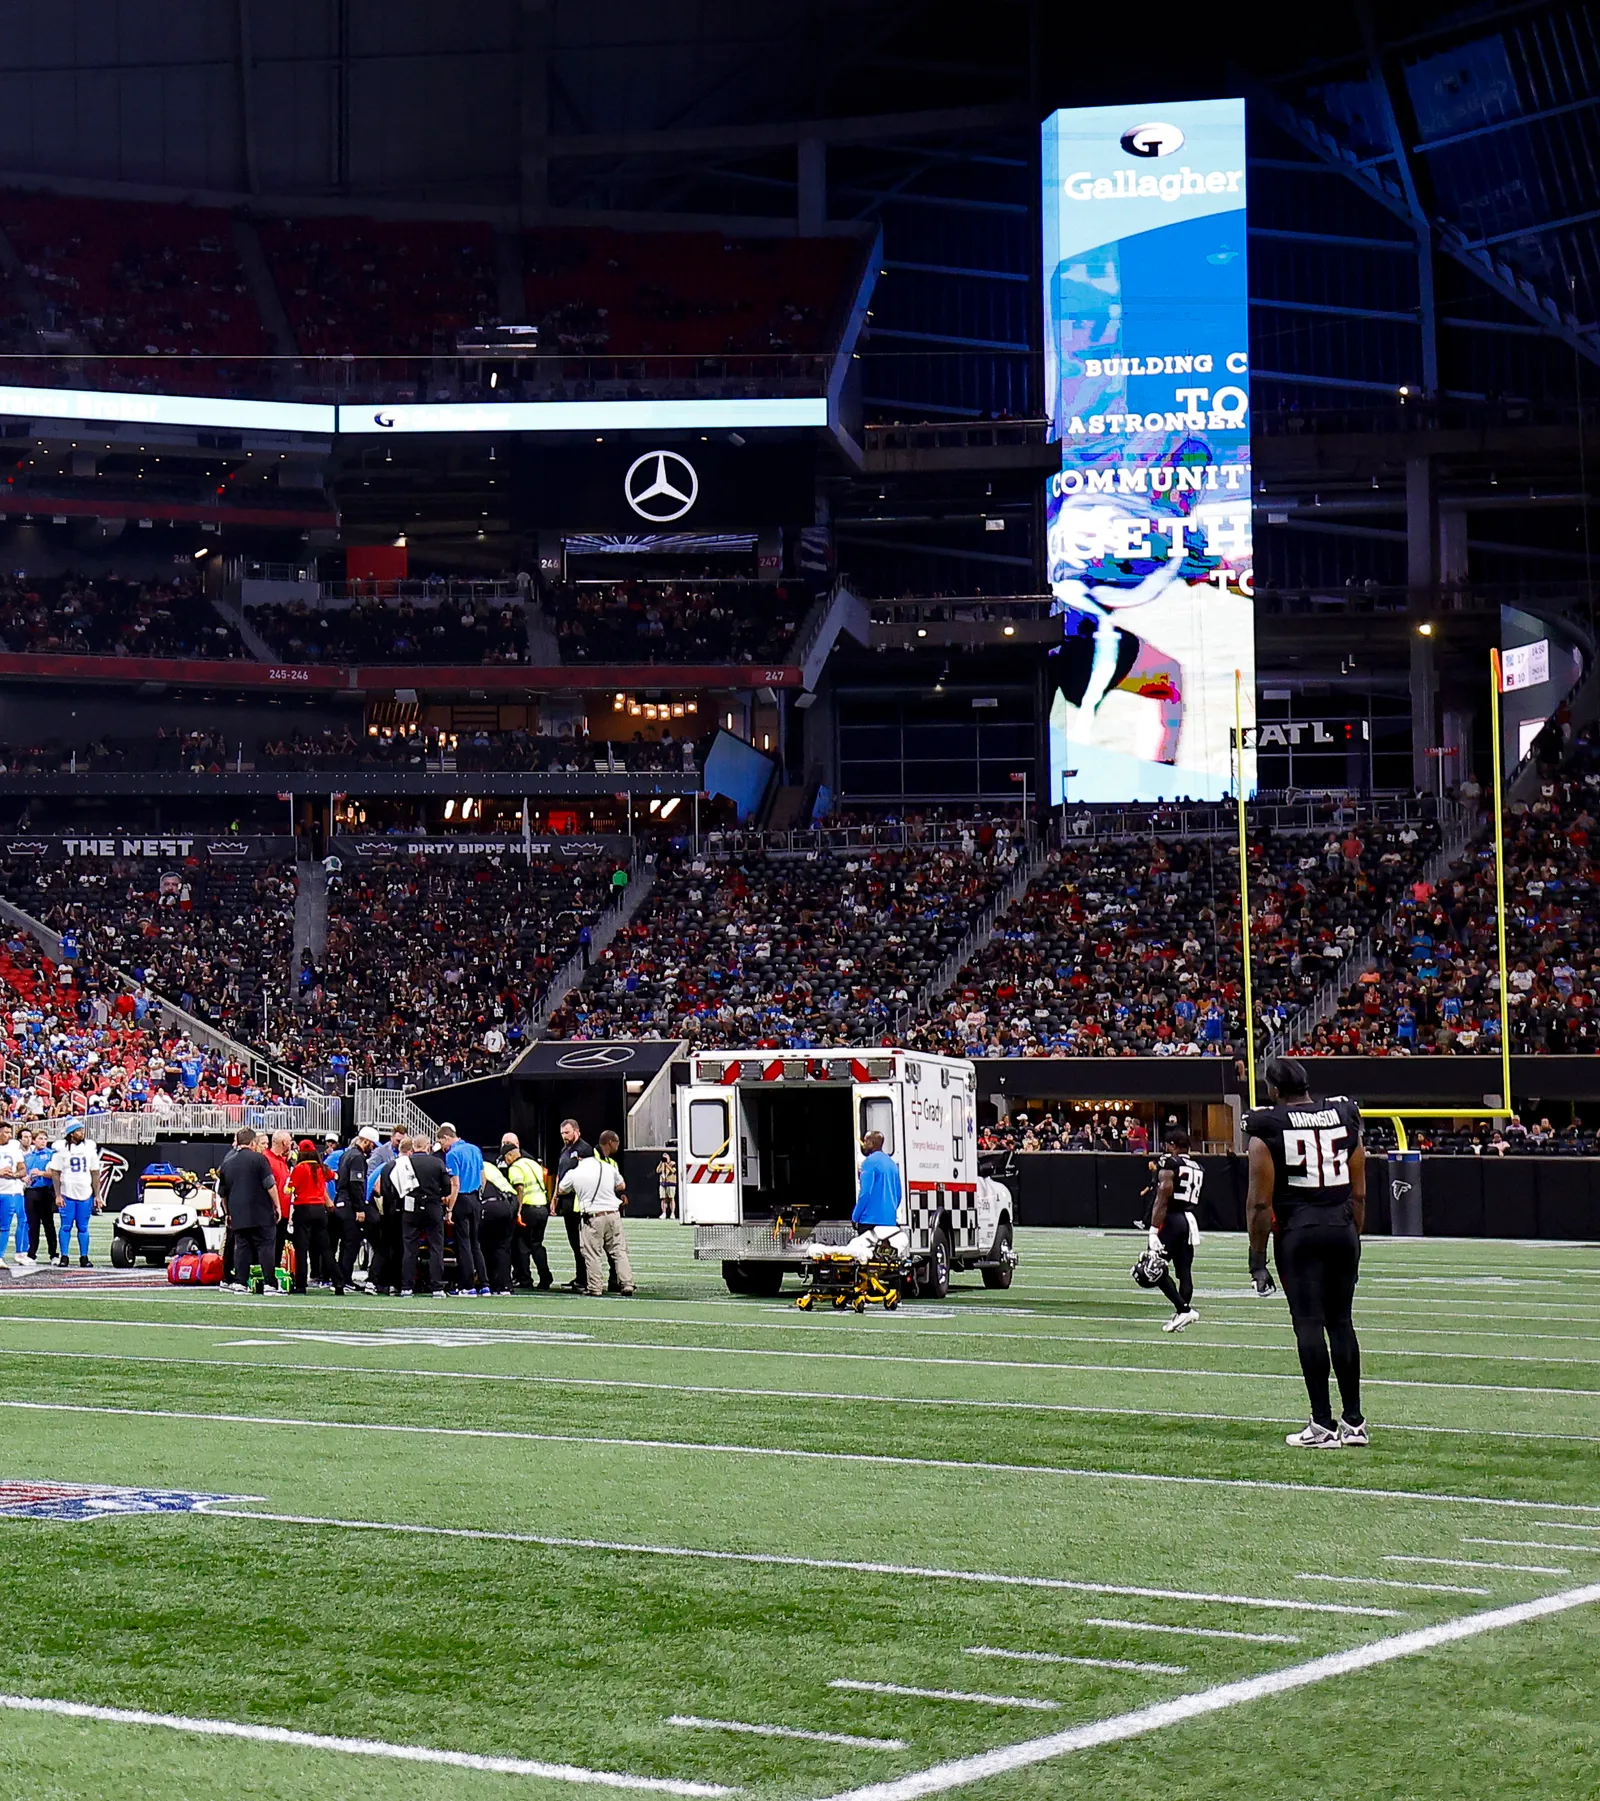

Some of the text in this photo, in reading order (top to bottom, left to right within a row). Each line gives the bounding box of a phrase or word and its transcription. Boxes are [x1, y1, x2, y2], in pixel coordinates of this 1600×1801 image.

[1064, 167, 1243, 202] Gallagher
[1085, 354, 1213, 377] BUILDING
[76, 395, 160, 419] Broker
[1175, 386, 1249, 421] TO
[1068, 416, 1086, 434] A
[1052, 464, 1252, 498] COMMUNIT
[541, 558, 559, 570] 246
[269, 668, 310, 682] 245-246
[764, 670, 785, 682] 247
[1259, 721, 1335, 747] ATL
[62, 839, 194, 857] THE NEST
[408, 843, 455, 855] DIRTY
[924, 1097, 944, 1129] Grady
[1288, 1108, 1341, 1128] HARRISON
[70, 1156, 87, 1173] 91
[1283, 1127, 1350, 1188] 96
[1174, 1166, 1204, 1204] 38
